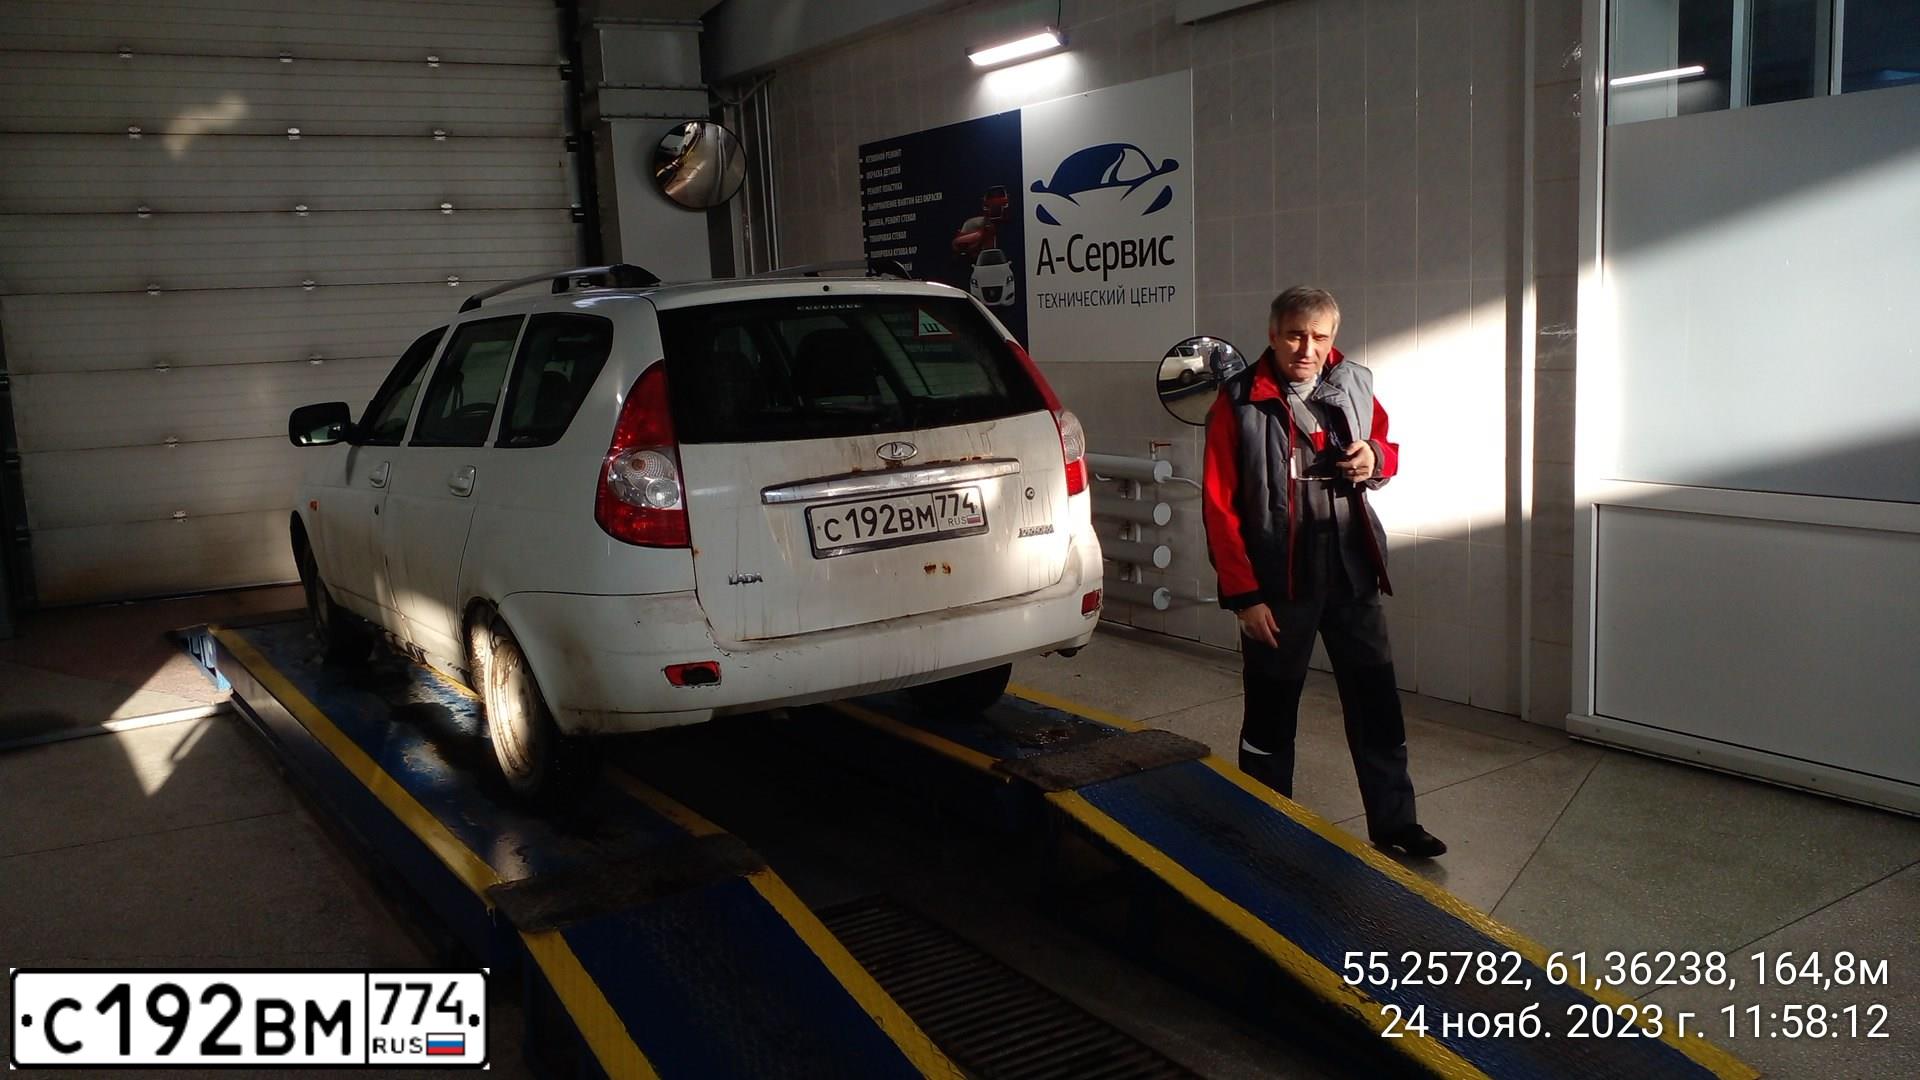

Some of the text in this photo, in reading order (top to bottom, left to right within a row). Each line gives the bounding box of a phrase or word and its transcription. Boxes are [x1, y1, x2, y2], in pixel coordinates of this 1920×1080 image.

[1036, 234, 1175, 281] А-Сервис
[1037, 284, 1176, 309] ТЕХНИЧЕСКИЙ ЦЕНТР
[935, 493, 975, 518] 774
[948, 517, 966, 526] RUS
[728, 573, 763, 585] LADA
